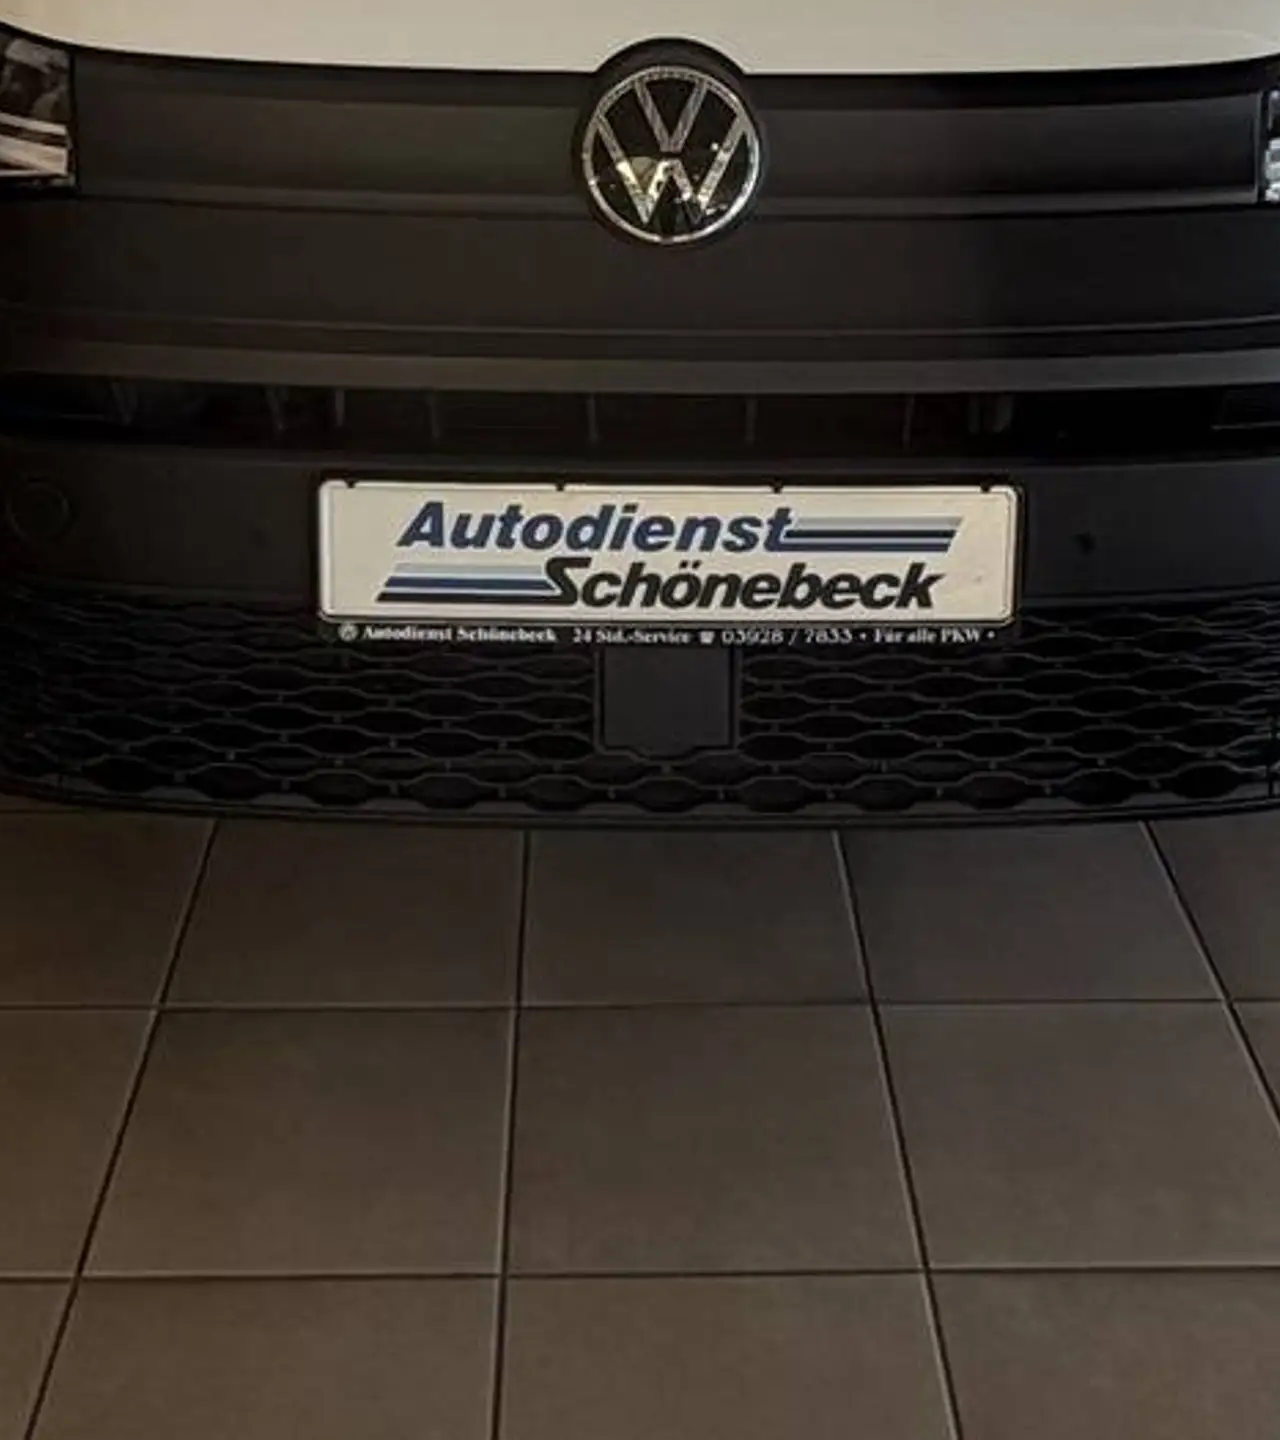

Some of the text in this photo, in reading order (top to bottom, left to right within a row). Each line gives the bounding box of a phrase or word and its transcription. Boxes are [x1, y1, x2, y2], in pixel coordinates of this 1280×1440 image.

[396, 501, 791, 552] Autodienst
[544, 556, 946, 609] Schönebeck
[362, 625, 453, 641] Autodienst
